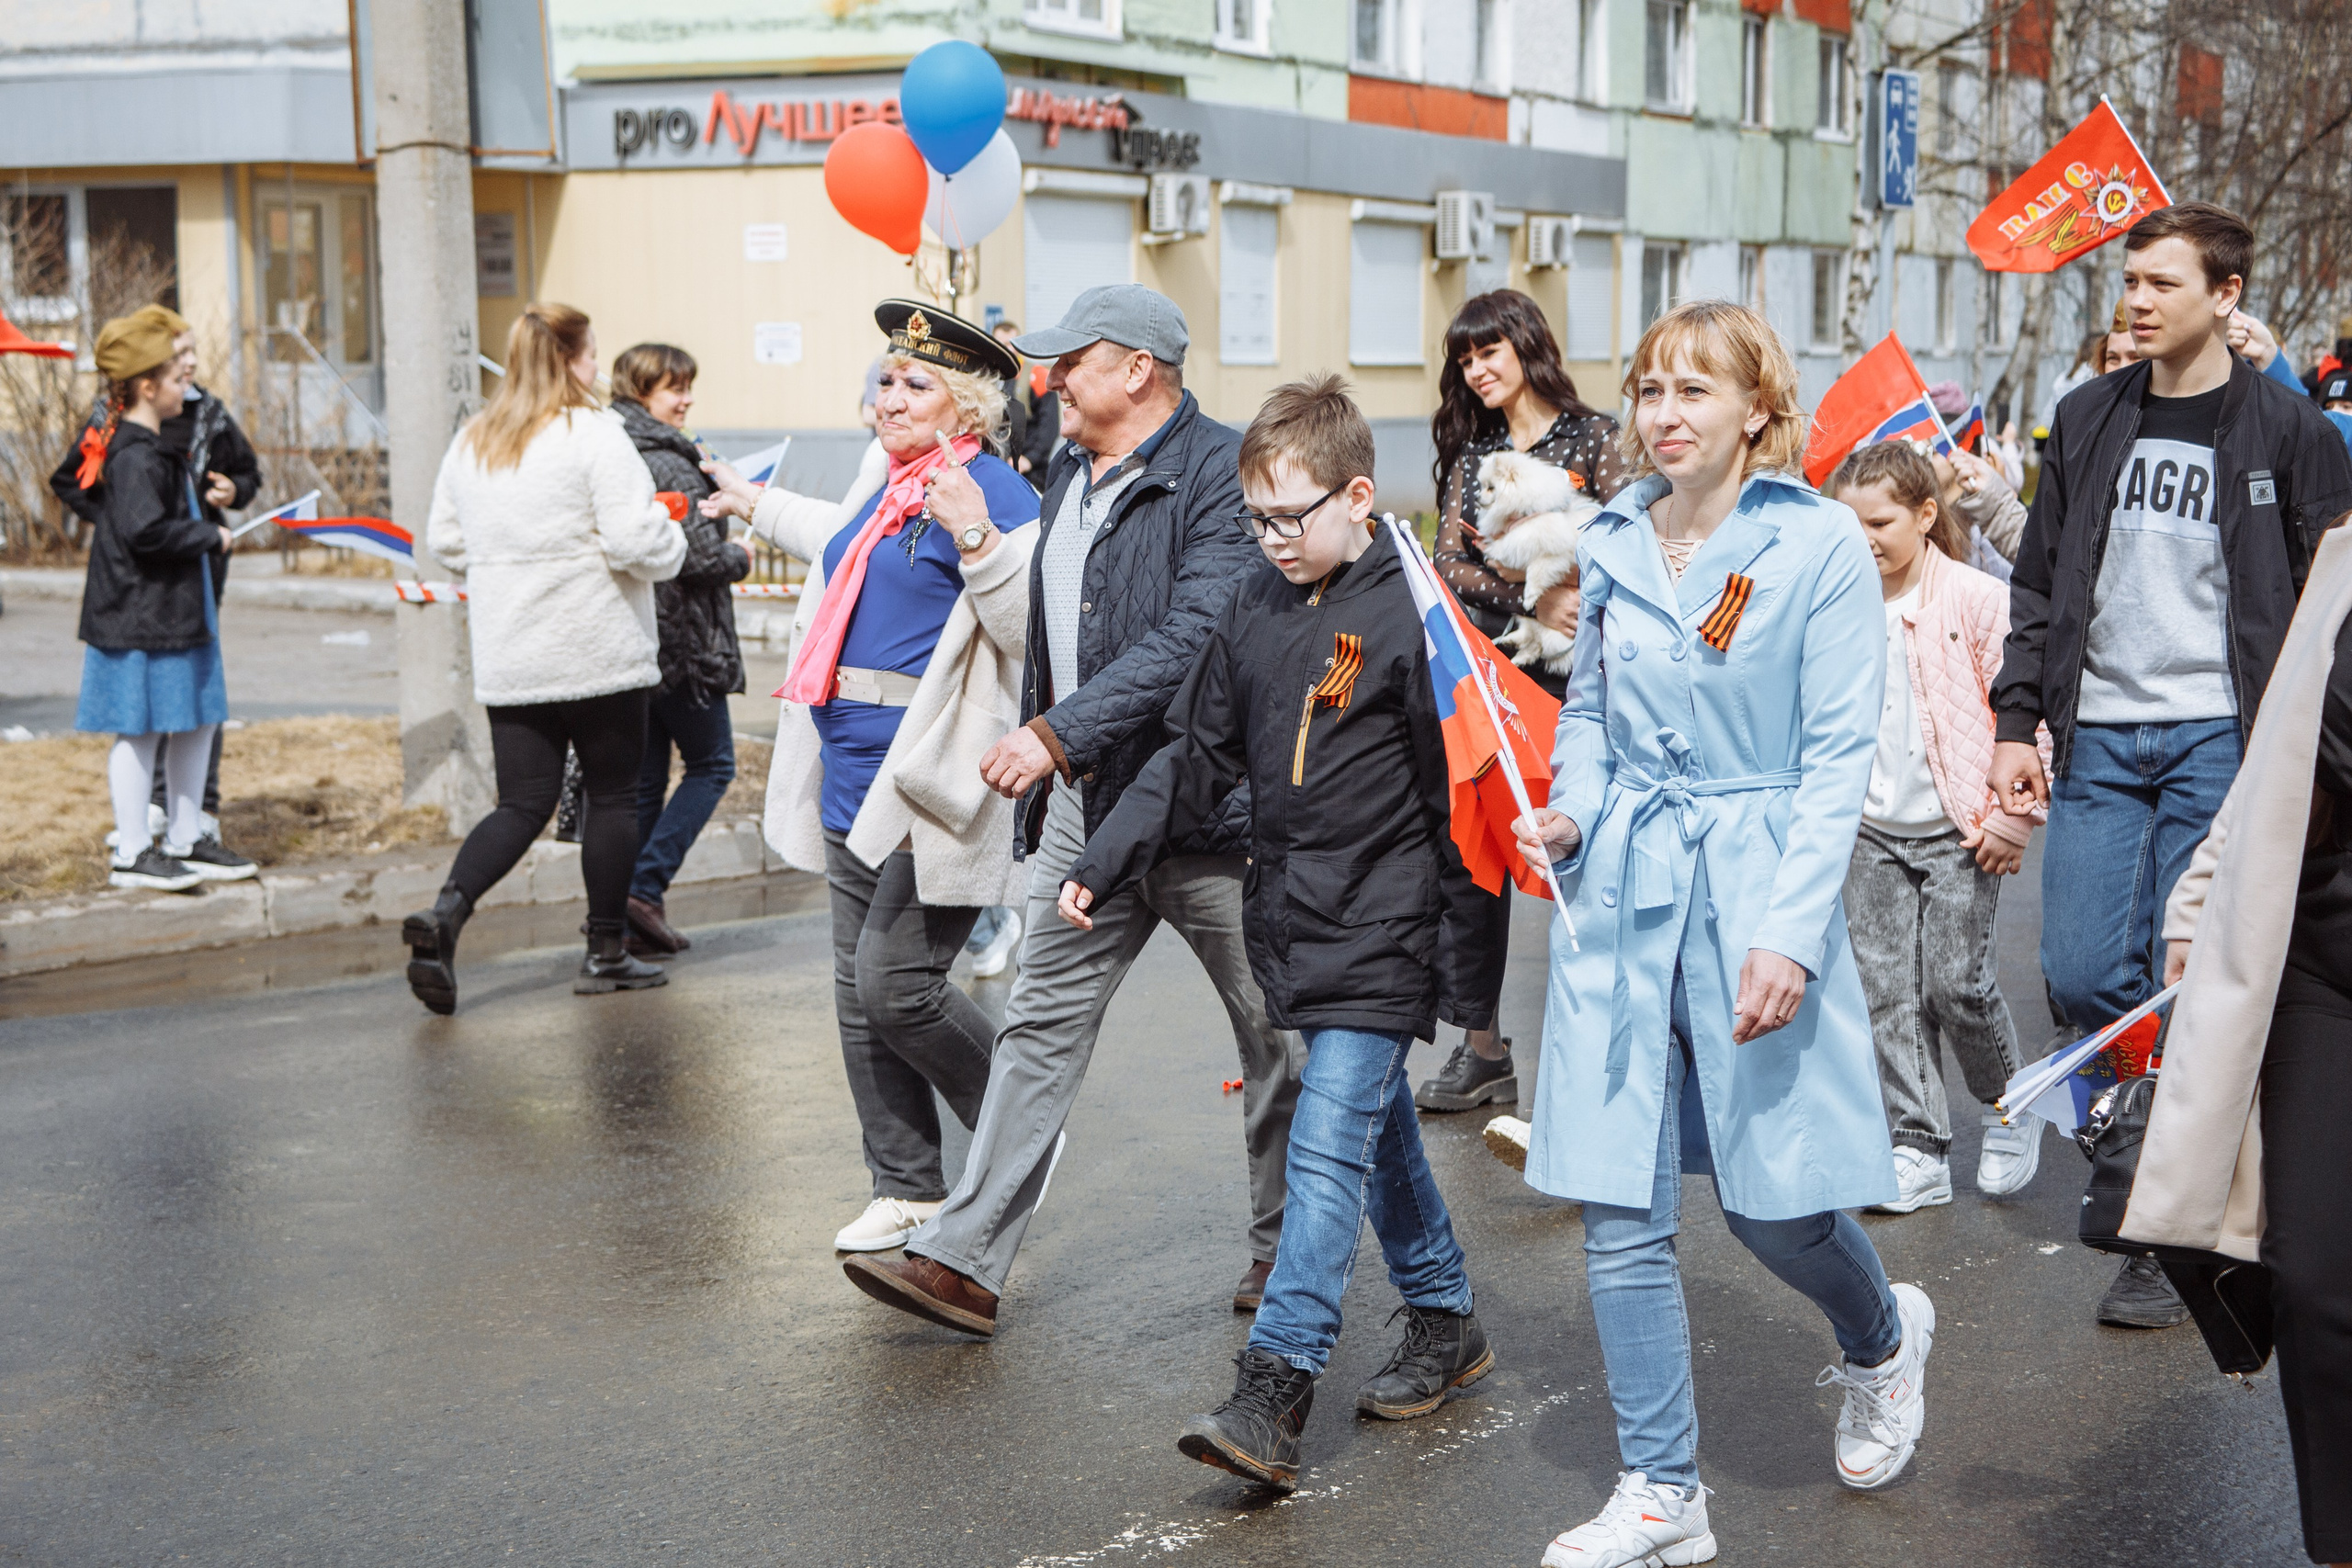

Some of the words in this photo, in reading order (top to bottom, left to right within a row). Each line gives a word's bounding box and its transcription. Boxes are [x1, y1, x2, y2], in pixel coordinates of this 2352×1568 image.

[615, 108, 696, 160] pro
[943, 348, 970, 366] ФЛОТ
[2111, 457, 2220, 526] AGR
